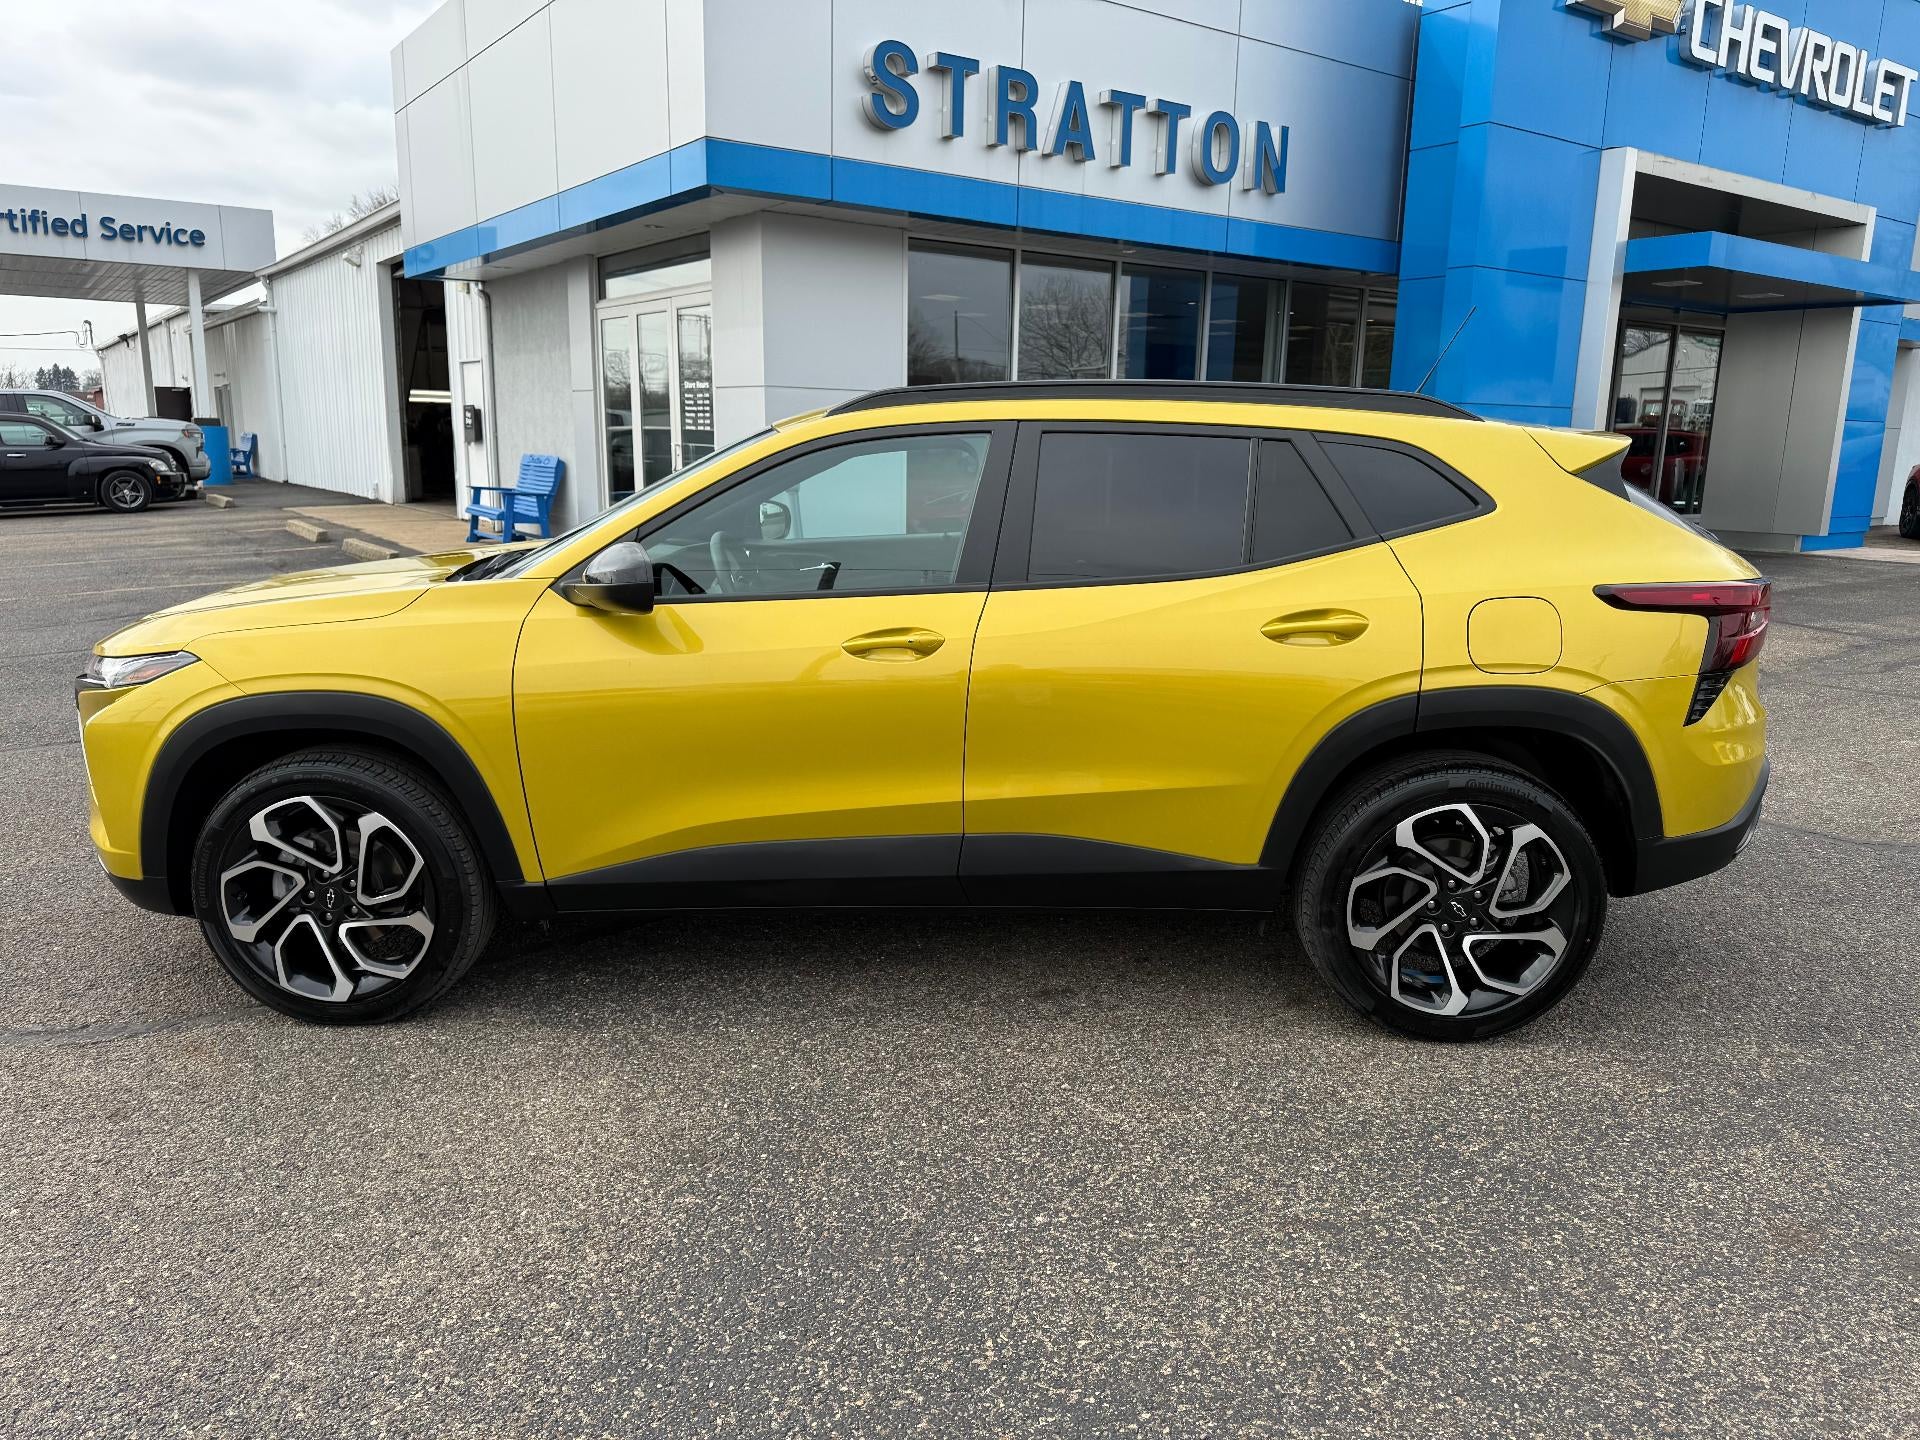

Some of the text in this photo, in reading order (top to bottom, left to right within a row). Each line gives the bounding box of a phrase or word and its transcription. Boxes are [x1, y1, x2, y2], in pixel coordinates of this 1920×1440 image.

[863, 39, 1290, 194] STRATTON
[1683, 0, 1919, 127] CHEVROLET
[100, 216, 206, 247] Service
